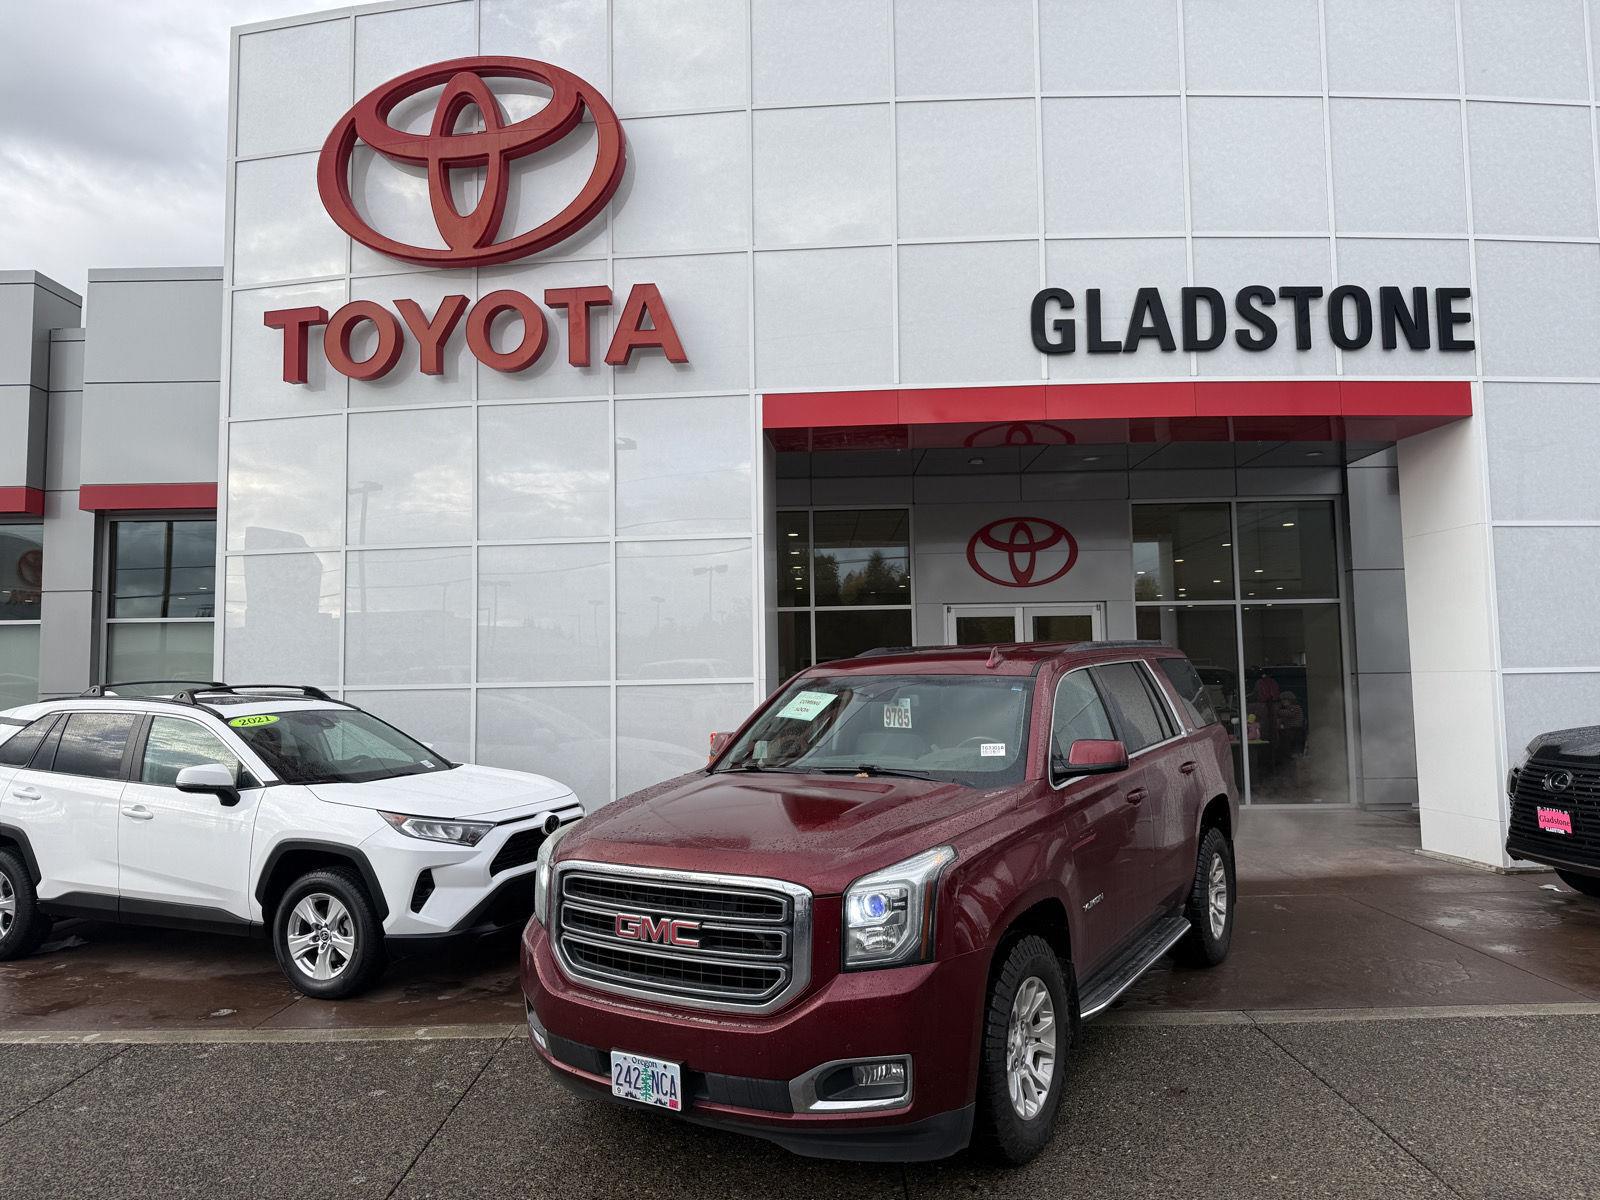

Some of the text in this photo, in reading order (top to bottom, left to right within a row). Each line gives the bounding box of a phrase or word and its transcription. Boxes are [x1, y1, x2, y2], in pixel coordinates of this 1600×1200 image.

[1031, 285, 1475, 353] GLADSTONE
[264, 283, 689, 384] TOYOTA
[239, 716, 271, 726] 2021
[885, 706, 910, 727] 9785
[1539, 815, 1571, 826] Gladstone
[615, 912, 700, 948] GMC
[631, 1056, 658, 1068] Oregon
[614, 1062, 677, 1100] 242 NCA
